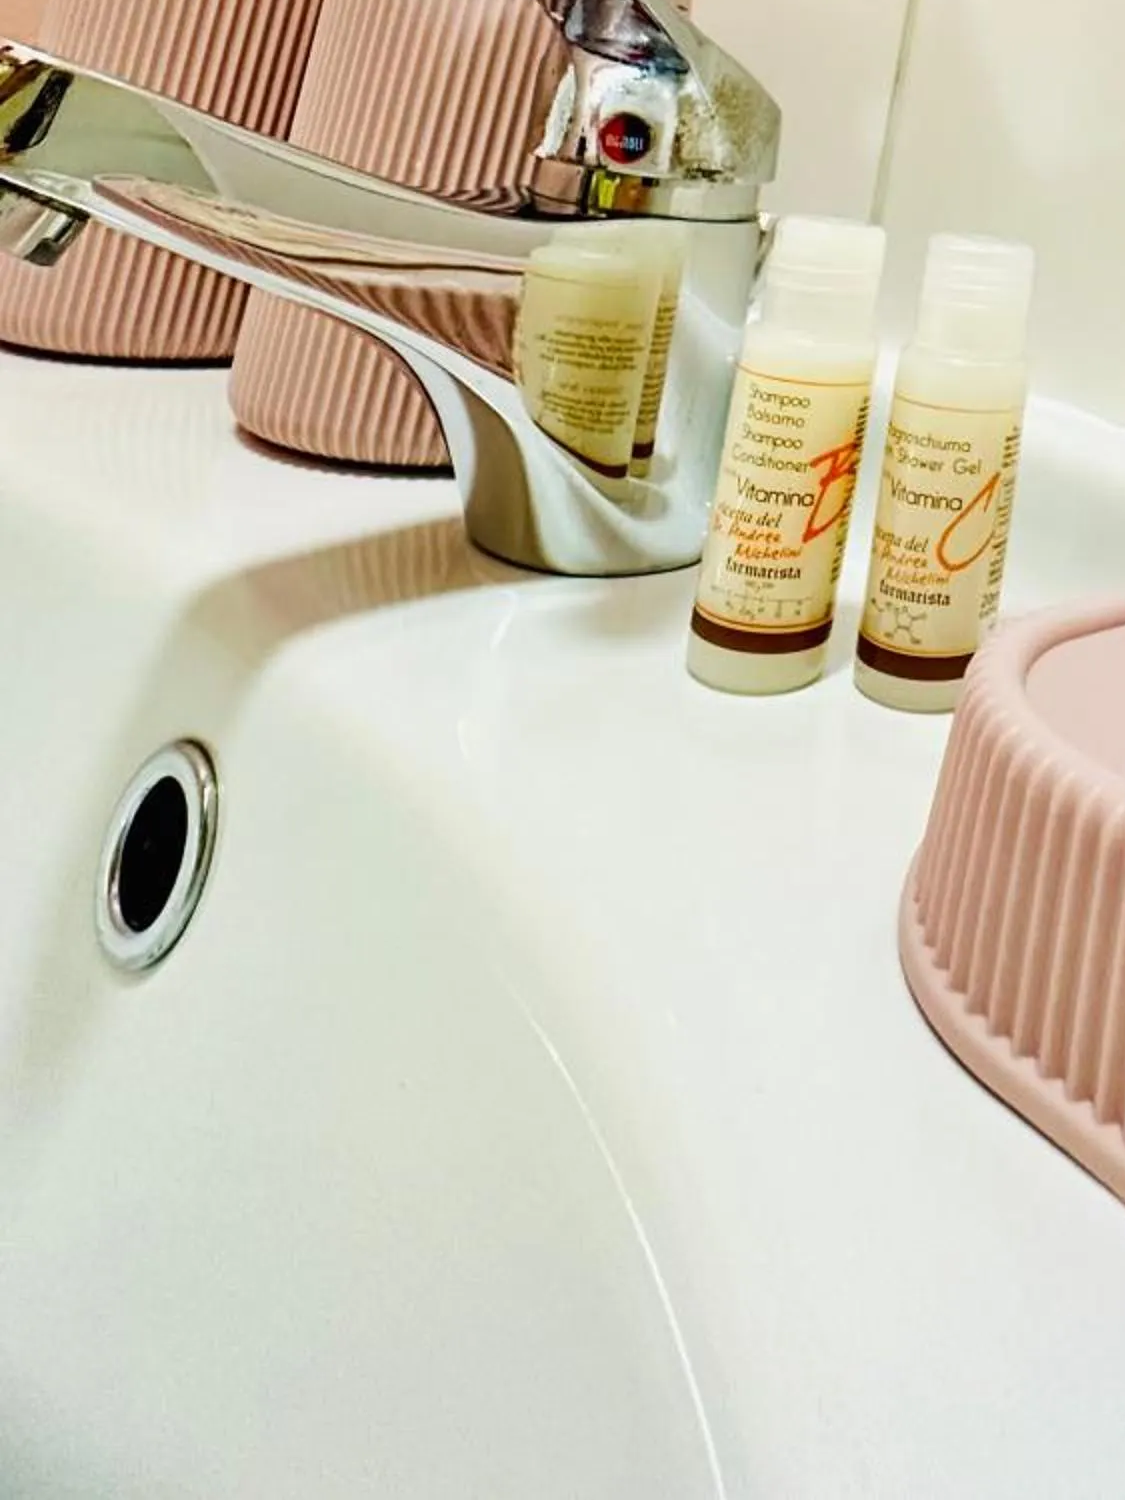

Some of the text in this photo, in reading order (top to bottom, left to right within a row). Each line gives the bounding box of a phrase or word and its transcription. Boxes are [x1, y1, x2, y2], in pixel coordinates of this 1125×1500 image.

[748, 382, 811, 412] Shampoo
[746, 403, 805, 429] Balsamo
[742, 423, 803, 453] Shampoo
[732, 443, 808, 474] Conditioner
[897, 446, 944, 473] Shower
[953, 458, 982, 477] Gel
[737, 476, 815, 508] Vitamina
[890, 477, 963, 512] Vitamina
[756, 511, 783, 528] del
[904, 534, 930, 553] del
